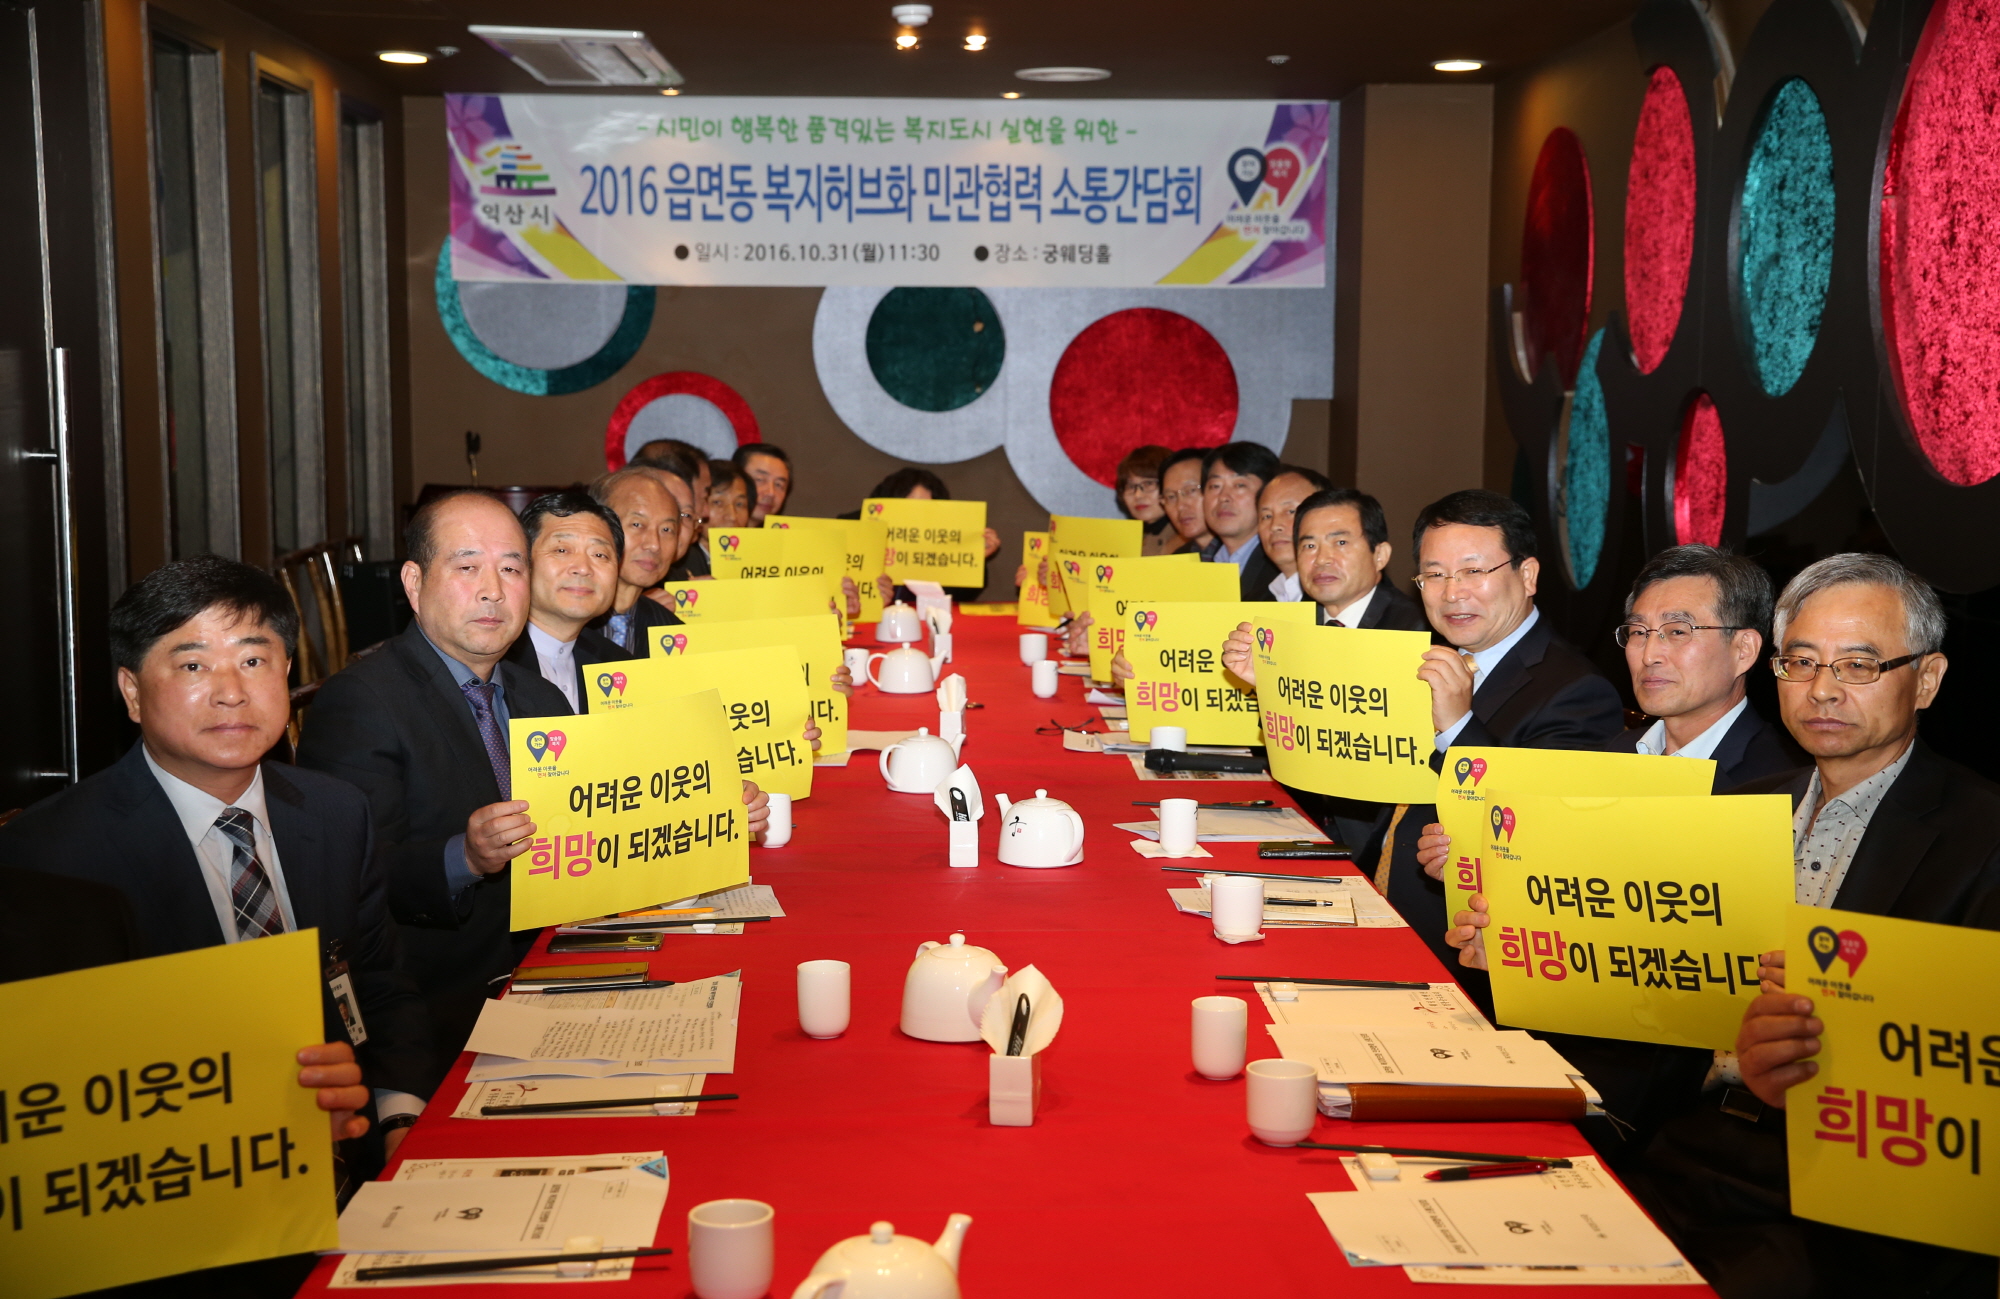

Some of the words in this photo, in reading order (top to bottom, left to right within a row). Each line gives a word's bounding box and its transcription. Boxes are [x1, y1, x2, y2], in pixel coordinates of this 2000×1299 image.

[656, 116, 722, 142] 시민이
[731, 115, 799, 144] 행복한
[806, 115, 895, 144] 품격있는
[904, 116, 992, 144] 복지도시
[1000, 116, 1066, 145] 실현을
[1074, 117, 1118, 145] 위한
[482, 203, 549, 225] 익산시
[580, 164, 658, 217] 2016
[664, 163, 757, 223] 읍면동
[763, 163, 917, 224] 복지허브화
[924, 164, 1042, 224] 민관협력
[1050, 165, 1202, 225] 소통간담회
[1041, 243, 1111, 264] 궁웨딩홀
[1160, 649, 1214, 673] 어려운
[723, 700, 771, 731] 웃의
[1136, 681, 1199, 713] 희망이
[1206, 688, 1259, 713] 되겠습
[1278, 675, 1324, 710] 어려운
[1330, 683, 1389, 717] 이웃의
[736, 739, 803, 775] 습니다.
[1264, 710, 1310, 753] 희망이
[1317, 724, 1425, 766] 되겠습니다.
[569, 775, 642, 818] 어려운
[650, 760, 711, 804] 이웃의
[528, 830, 619, 880] 희망이
[627, 808, 739, 863] 되겠습니다.
[1526, 874, 1615, 919] 어려운
[1623, 880, 1723, 927] 이웃의
[1499, 926, 1600, 983] 희망이
[85, 1051, 233, 1123] 이웃의
[1815, 1086, 1981, 1176] 희망이
[44, 1126, 309, 1218] 되겠습니다.
